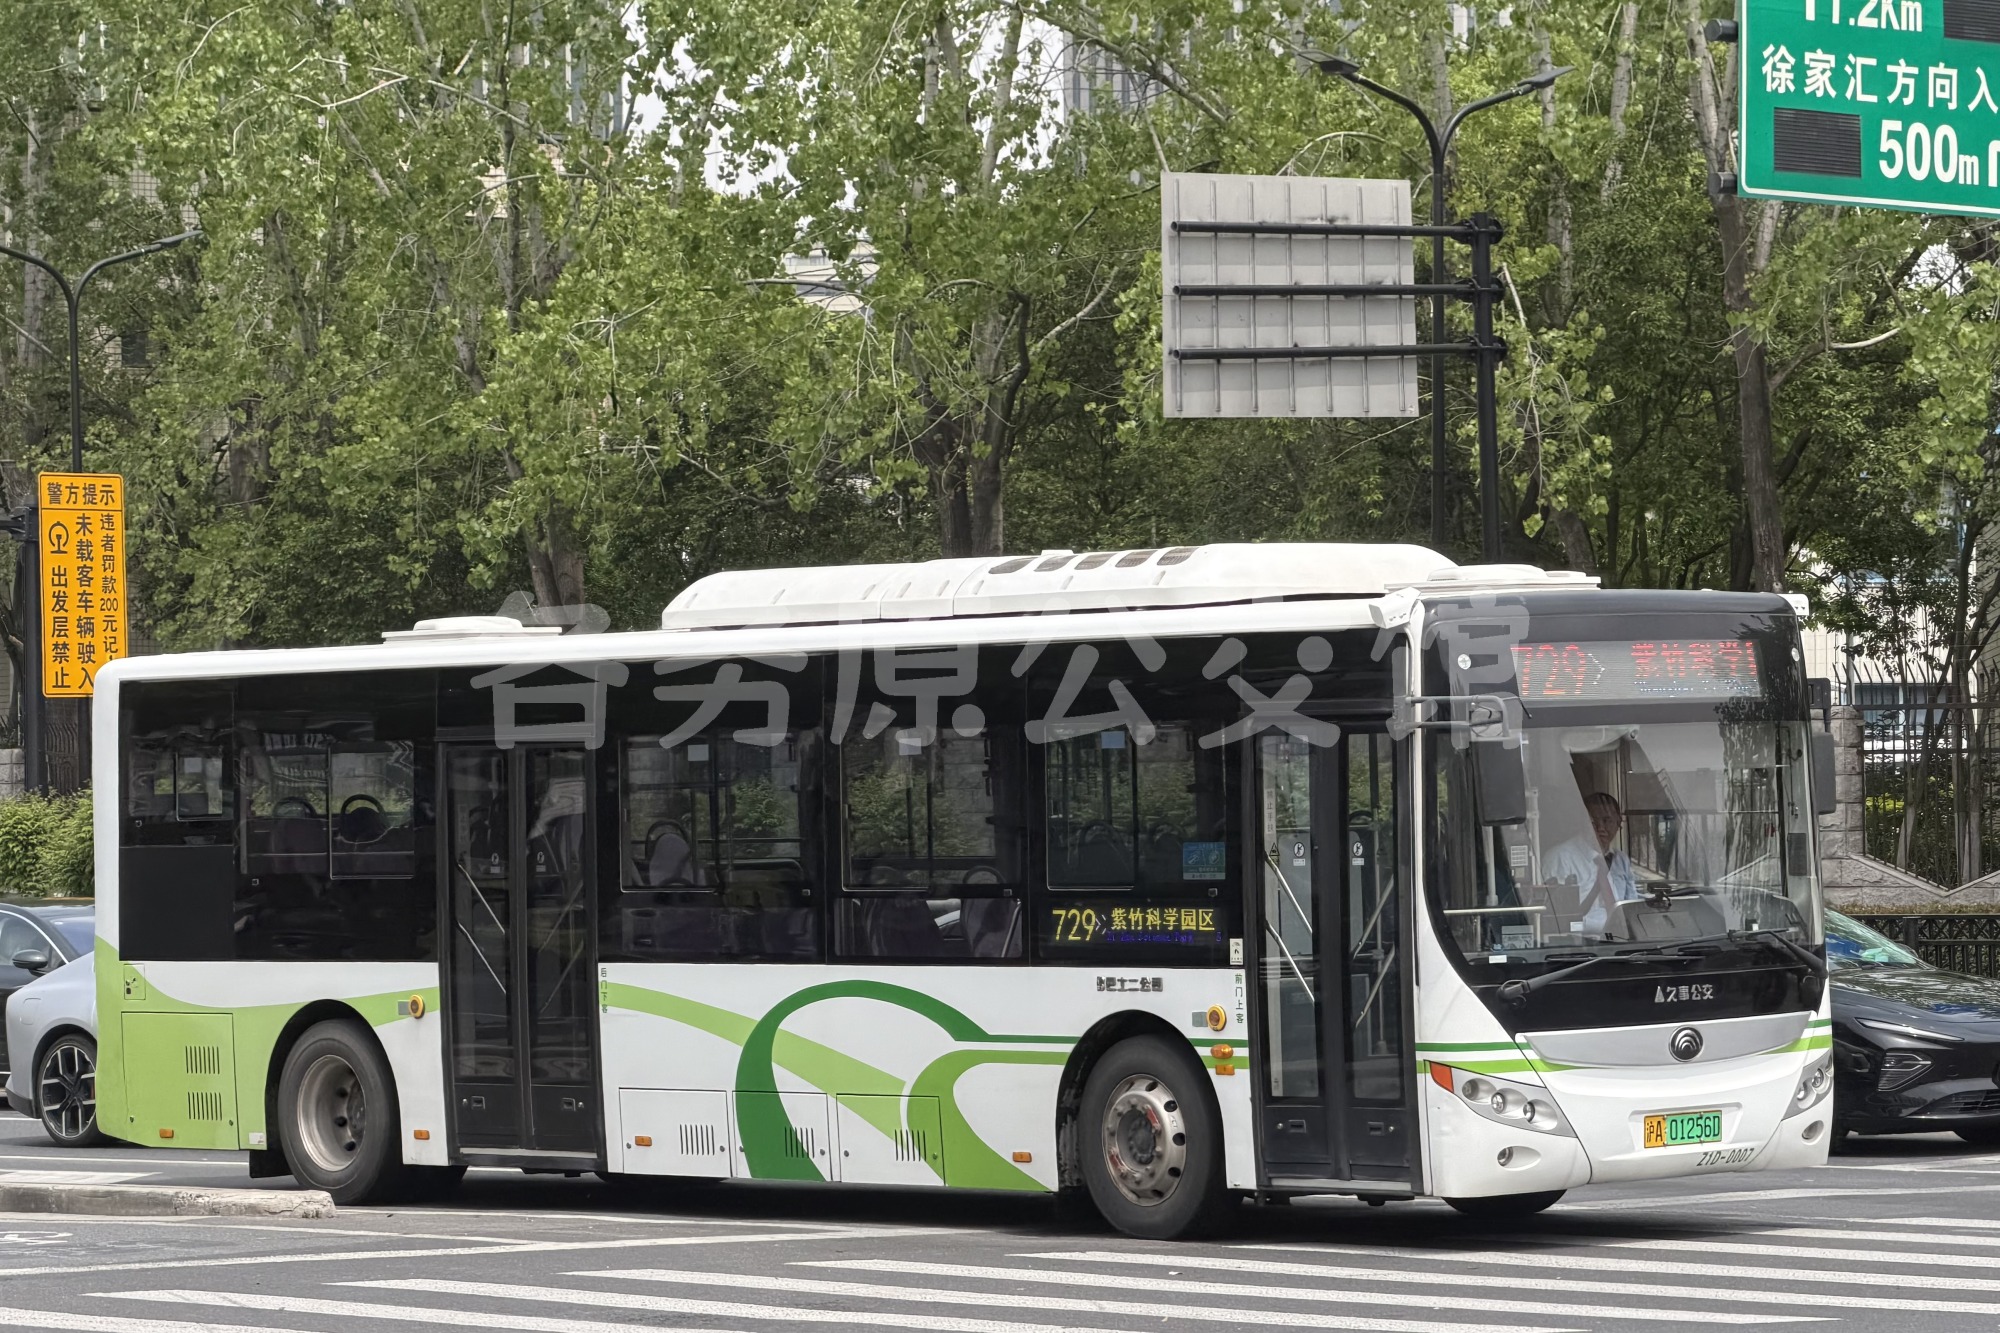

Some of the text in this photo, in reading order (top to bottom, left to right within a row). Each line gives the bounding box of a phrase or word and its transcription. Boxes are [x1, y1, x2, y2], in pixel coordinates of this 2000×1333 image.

[1761, 43, 1999, 114] 徐家汇方向入
[1879, 119, 1980, 186] 500m
[47, 482, 115, 505] 警方提示
[75, 513, 96, 690] 未载客车辆驶入
[100, 513, 119, 661] 违者罚款200元记
[51, 565, 71, 689] 出发层禁止
[1510, 644, 1587, 696] 729
[1052, 908, 1096, 941] 729
[1110, 907, 1215, 931] 紫竹科学园区
[1234, 973, 1245, 1024] 前门上客
